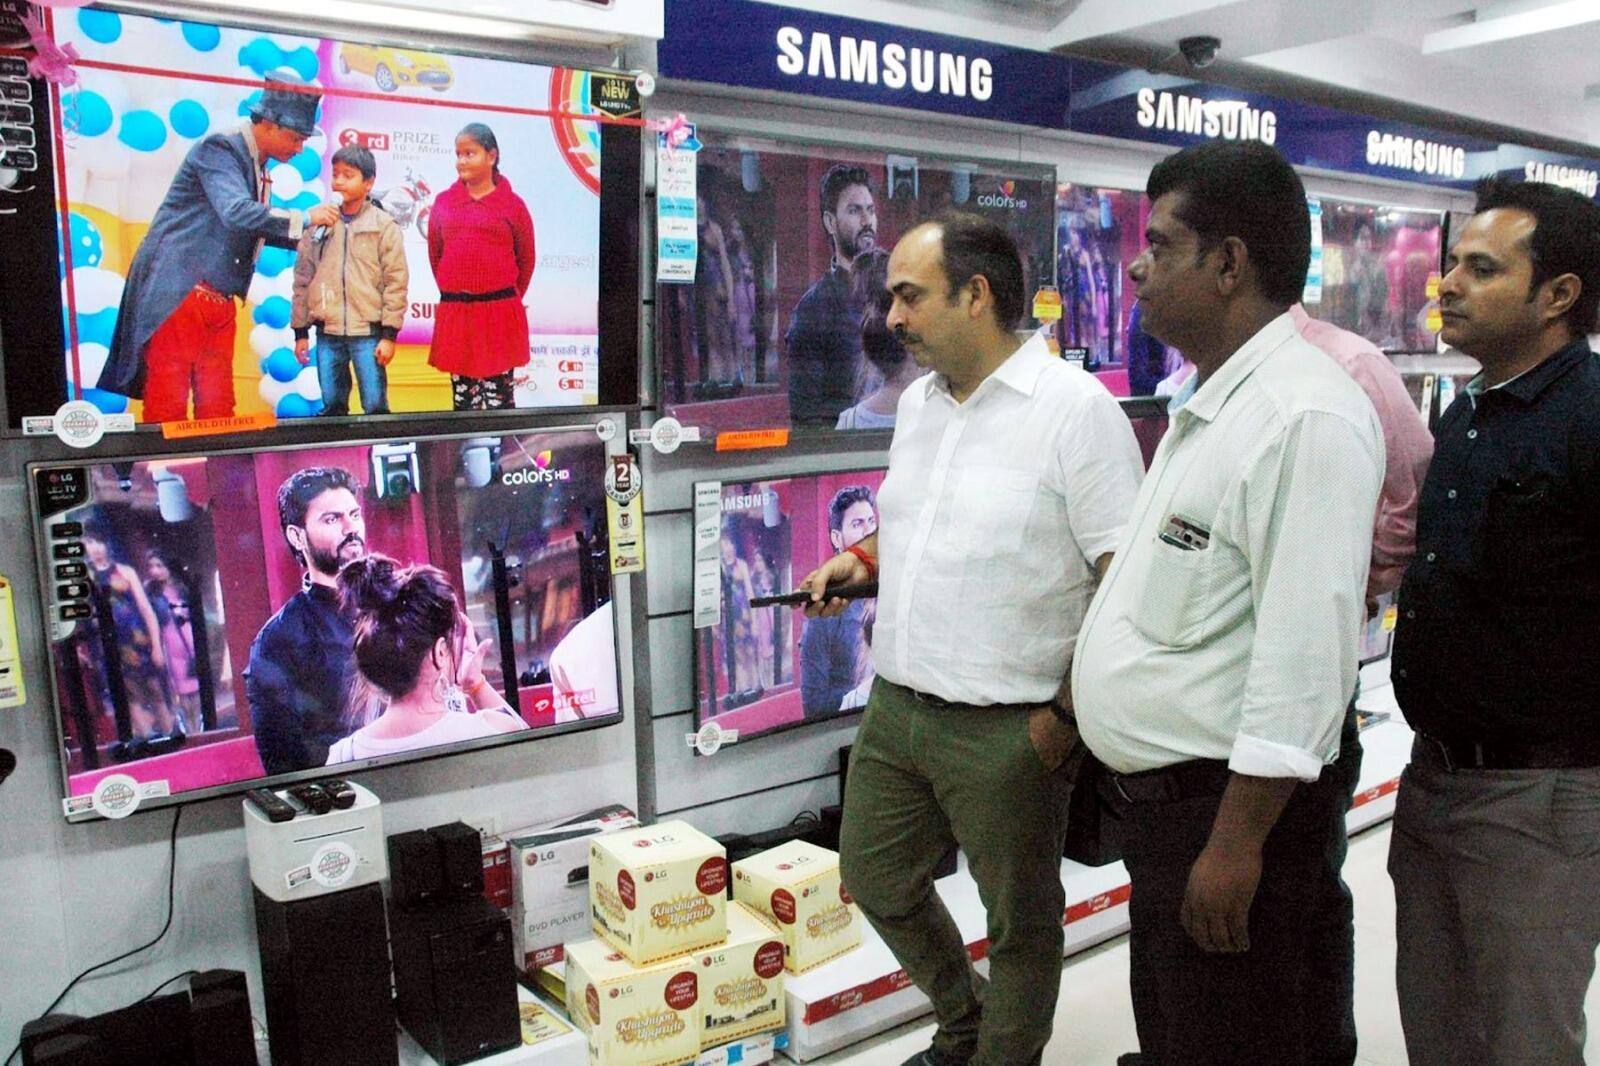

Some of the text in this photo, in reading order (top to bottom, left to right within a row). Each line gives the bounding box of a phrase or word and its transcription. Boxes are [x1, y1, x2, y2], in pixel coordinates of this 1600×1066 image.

[776, 26, 993, 101] SAMSUNG
[601, 85, 630, 99] NEW
[1137, 87, 1277, 145] SAMSUNG
[367, 135, 385, 148] rd
[393, 131, 440, 145] PRIZE
[1366, 130, 1465, 178] SAMSUNG
[977, 193, 1028, 208] colors HD
[176, 422, 209, 432] AIRTEL
[61, 473, 73, 482] LG
[502, 468, 570, 486] colors HD
[616, 463, 630, 482] 2
[720, 493, 771, 511] AMSUNG
[541, 850, 555, 861] LG
[655, 870, 667, 879] LG
[529, 911, 585, 933] DVD PLAYER
[713, 954, 725, 964] LG
[621, 986, 633, 995] LG
